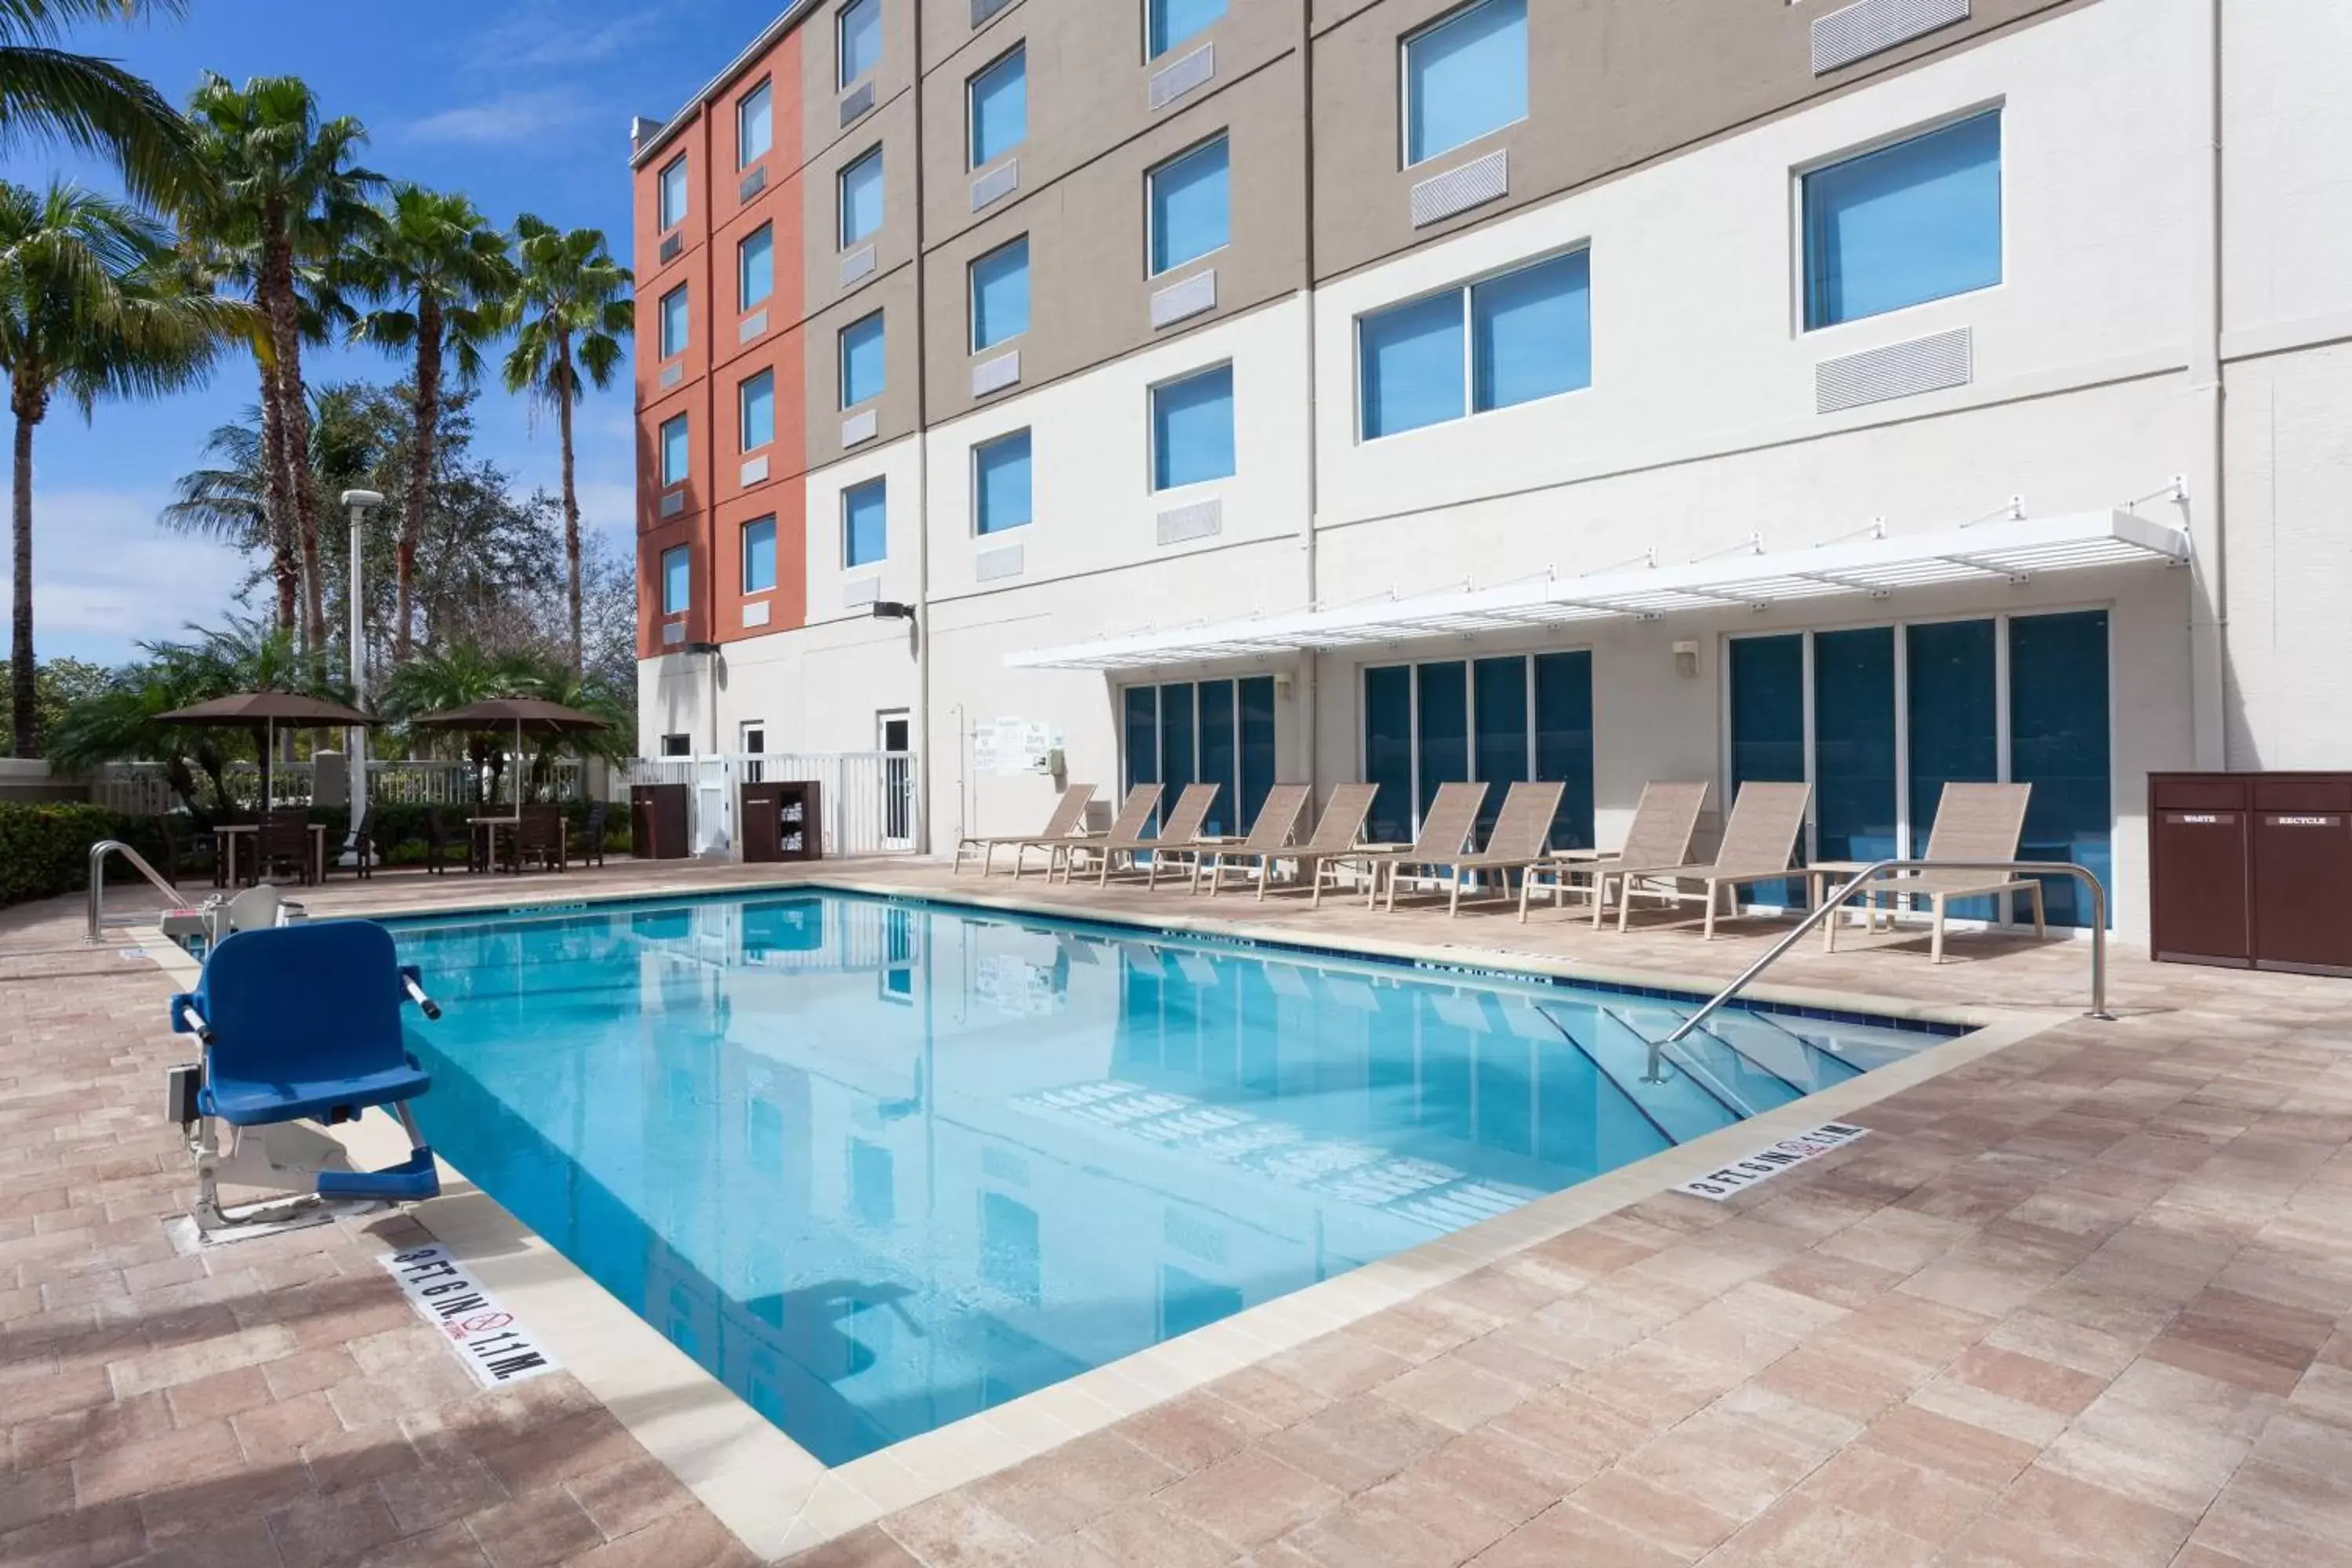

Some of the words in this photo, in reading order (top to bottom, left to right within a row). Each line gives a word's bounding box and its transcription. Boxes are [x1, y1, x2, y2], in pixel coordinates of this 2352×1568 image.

[2278, 816, 2327, 825] RECYCLE
[1688, 1183, 1726, 1194] 3
[1737, 1162, 1775, 1171] 6
[393, 1249, 437, 1263] 3
[422, 1280, 469, 1296] 6
